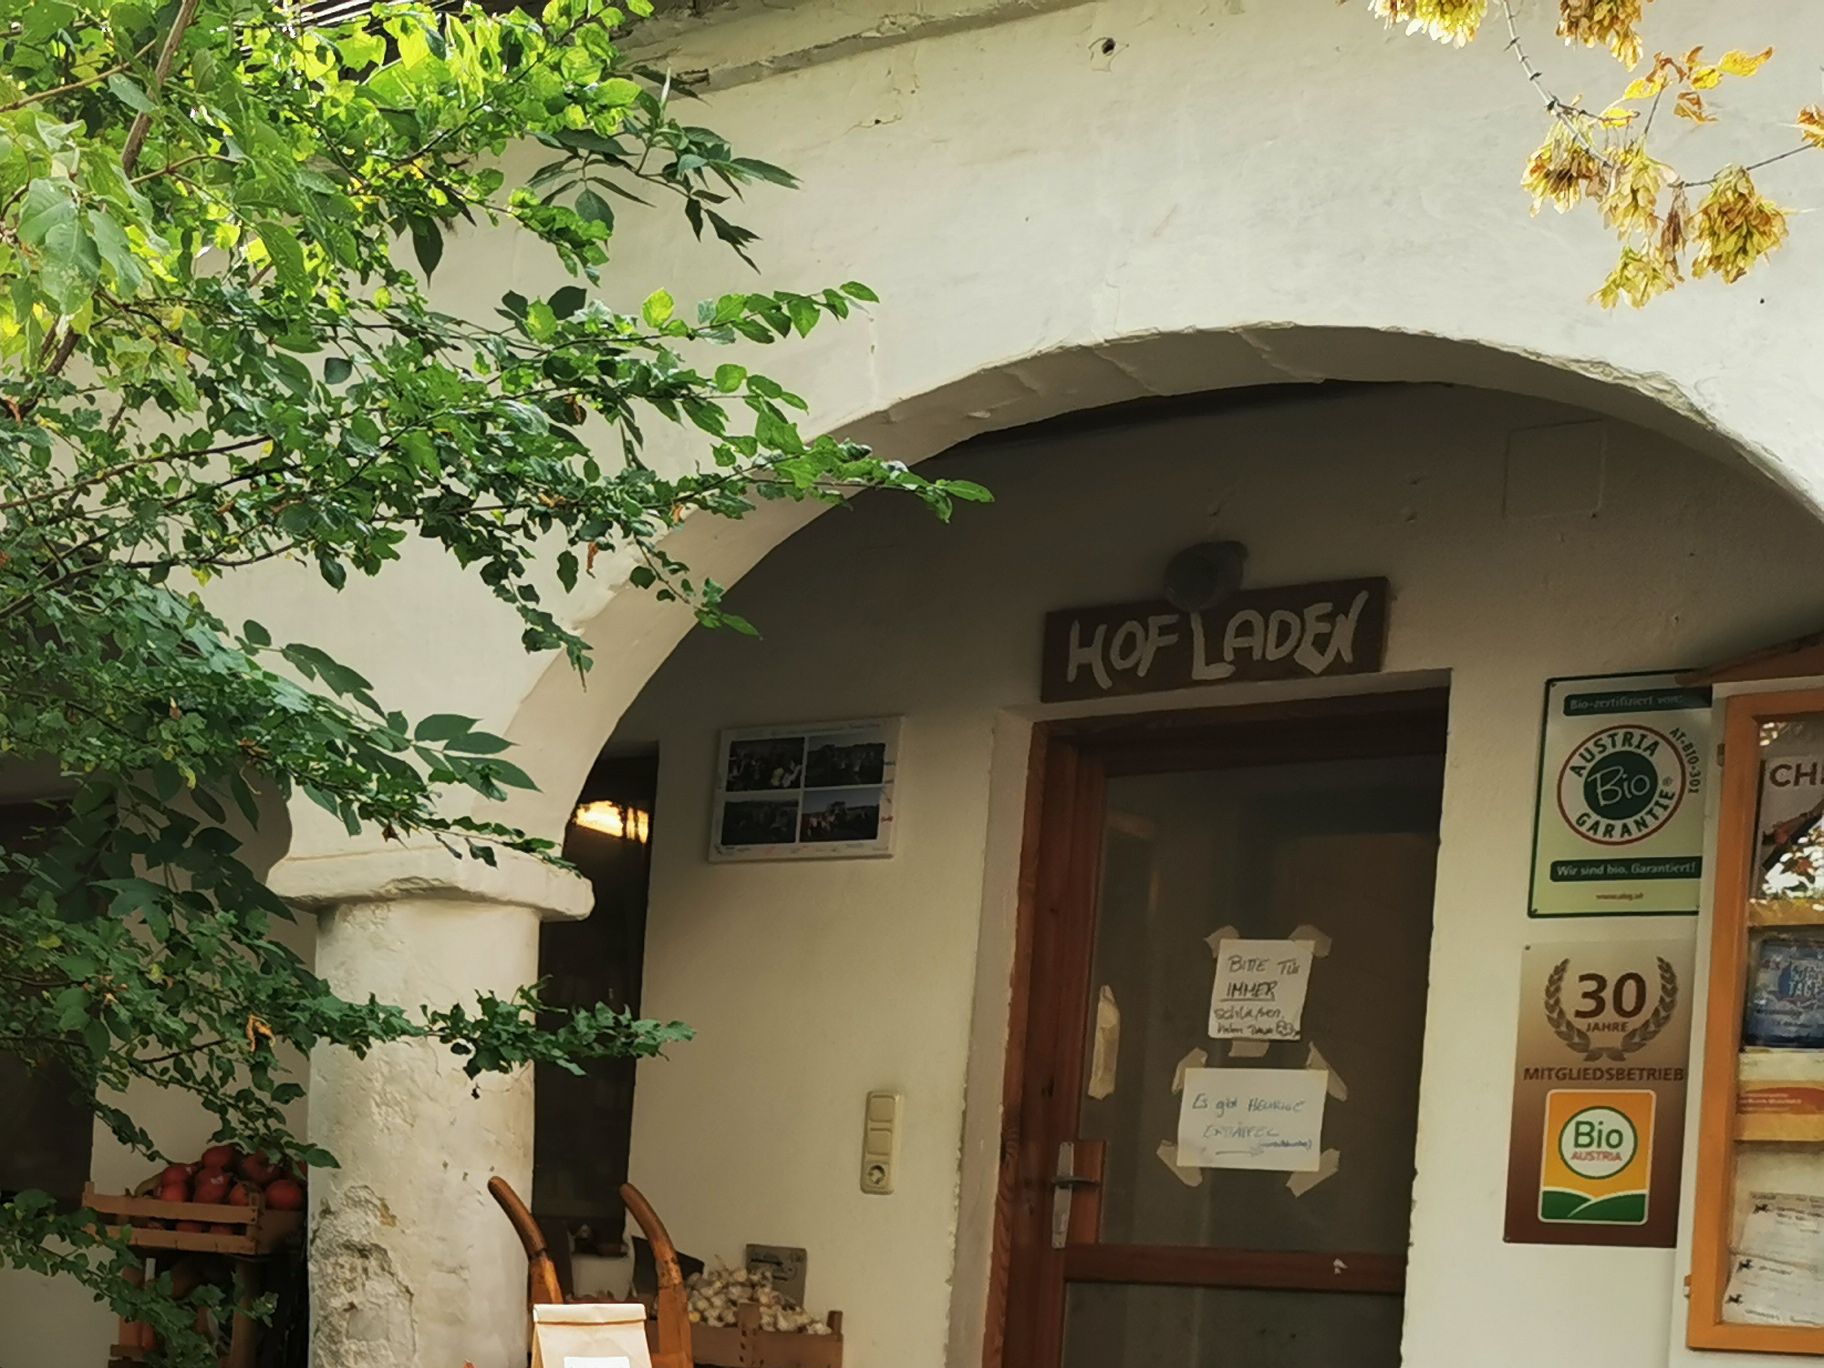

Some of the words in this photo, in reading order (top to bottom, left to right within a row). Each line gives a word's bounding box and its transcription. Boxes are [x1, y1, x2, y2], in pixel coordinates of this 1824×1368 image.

[1067, 613, 1179, 690] HOF
[1191, 589, 1369, 681] LADEN
[1569, 731, 1661, 778] AUSTRIA
[1586, 766, 1651, 806] Bio
[1769, 762, 1824, 788] CH
[1576, 789, 1676, 839] GARANTIE
[1557, 865, 1578, 876] Wir
[1581, 864, 1605, 875] sind
[1226, 981, 1277, 1001] IMMER
[1574, 972, 1647, 1019] 30
[1586, 1021, 1629, 1033] JAHRE
[1524, 1066, 1685, 1082] MITGLIEDSBETRIEB
[1573, 1120, 1624, 1149] Bio
[1570, 1151, 1623, 1162] AUSTRIA
